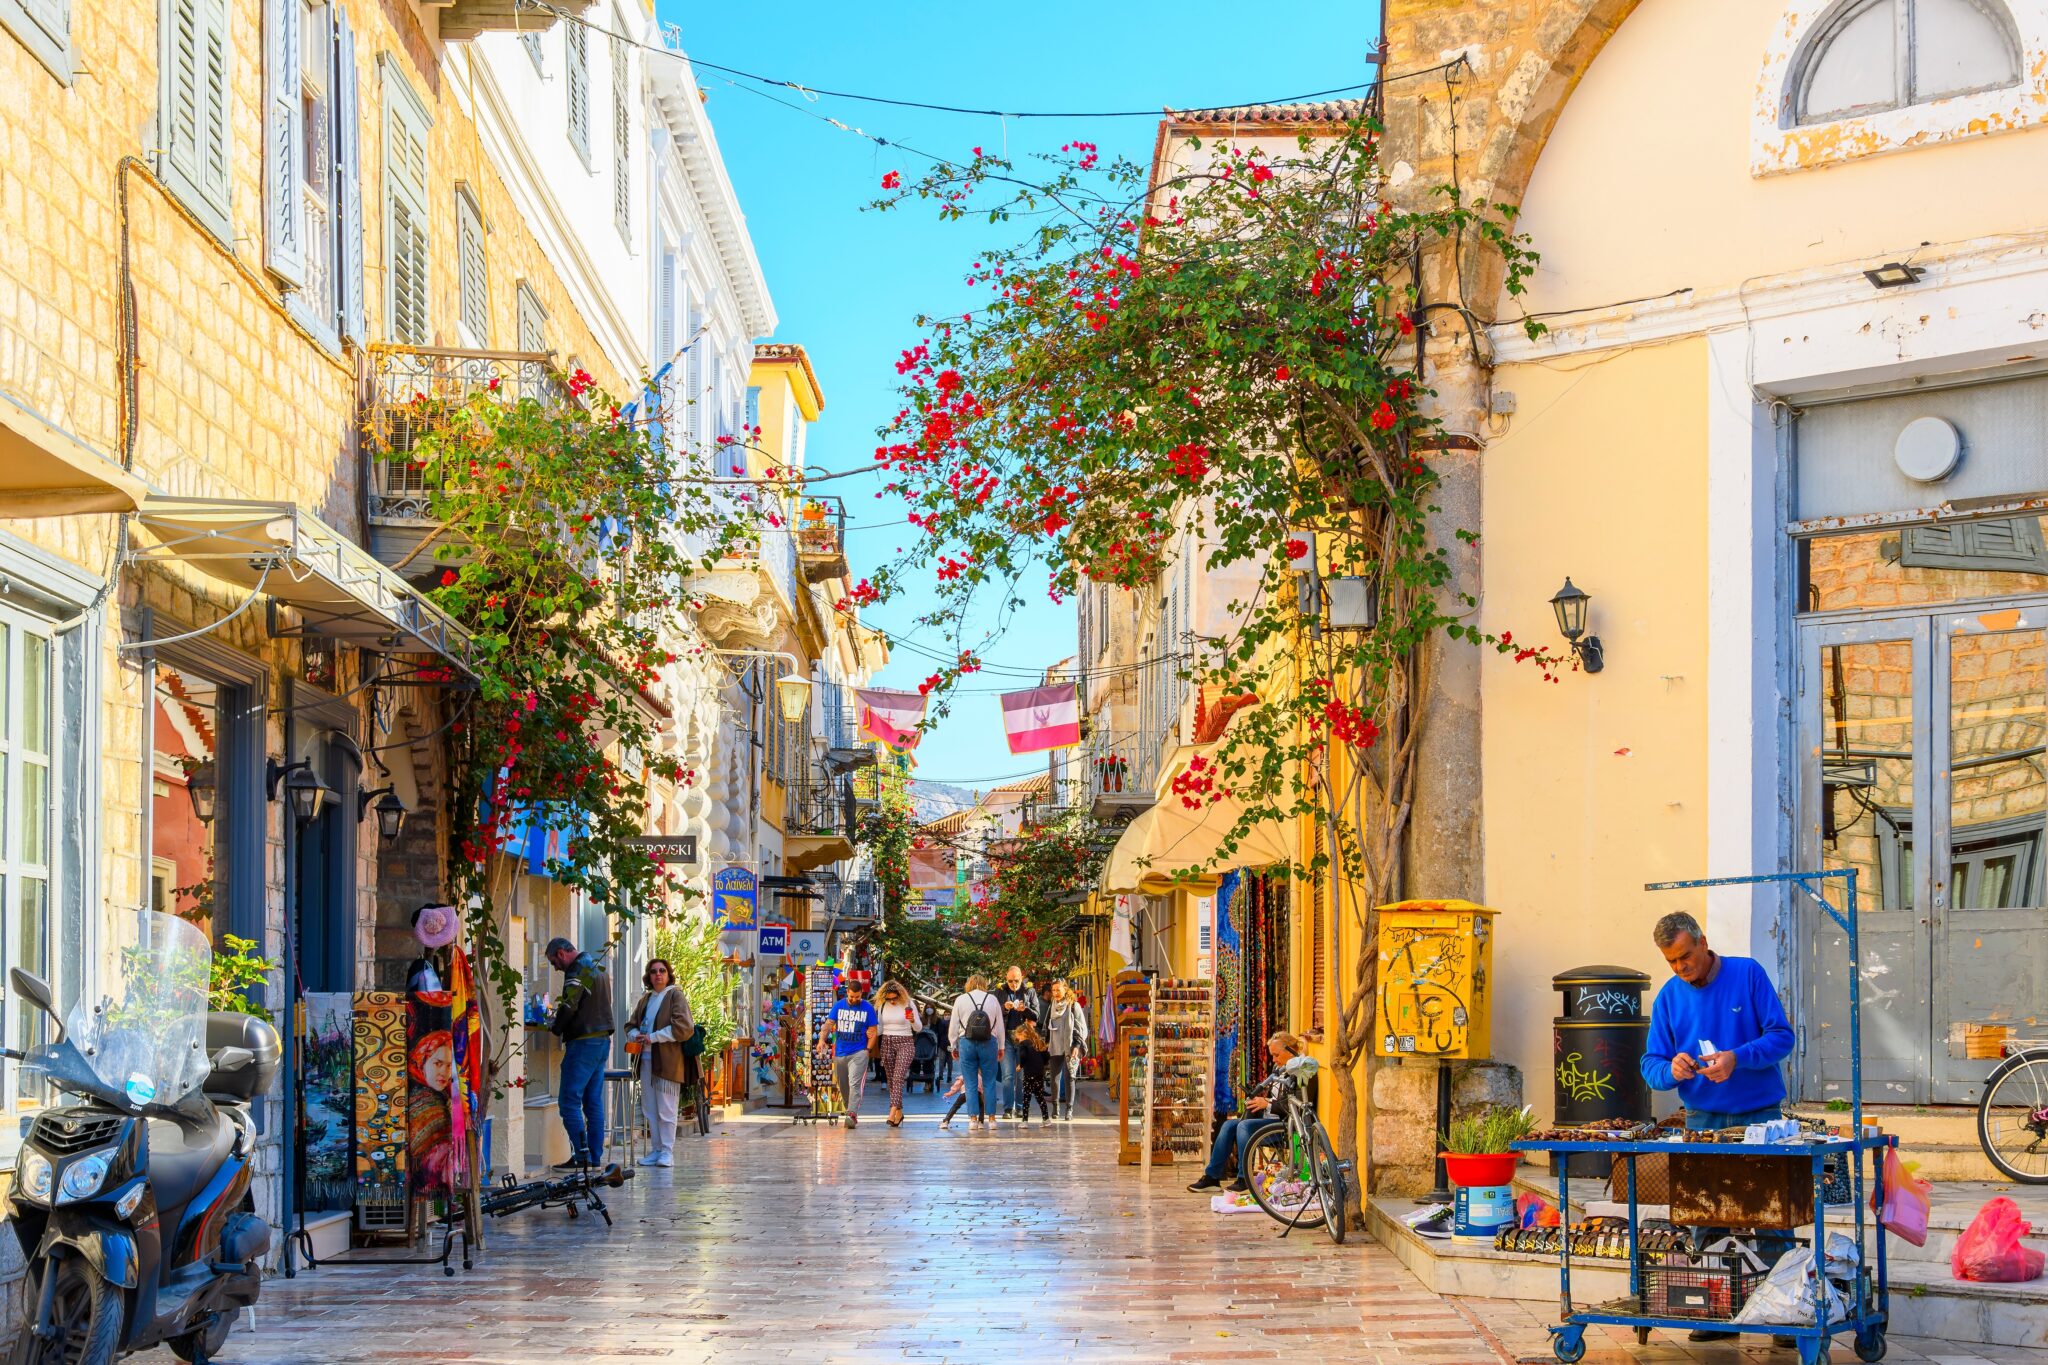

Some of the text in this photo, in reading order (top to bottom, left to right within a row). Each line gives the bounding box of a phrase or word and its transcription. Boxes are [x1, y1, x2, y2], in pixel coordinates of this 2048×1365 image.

[622, 844, 691, 856] WROVSKI
[761, 936, 783, 946] ATM
[837, 1009, 868, 1023] URBAN
[837, 1020, 856, 1033] MEN
